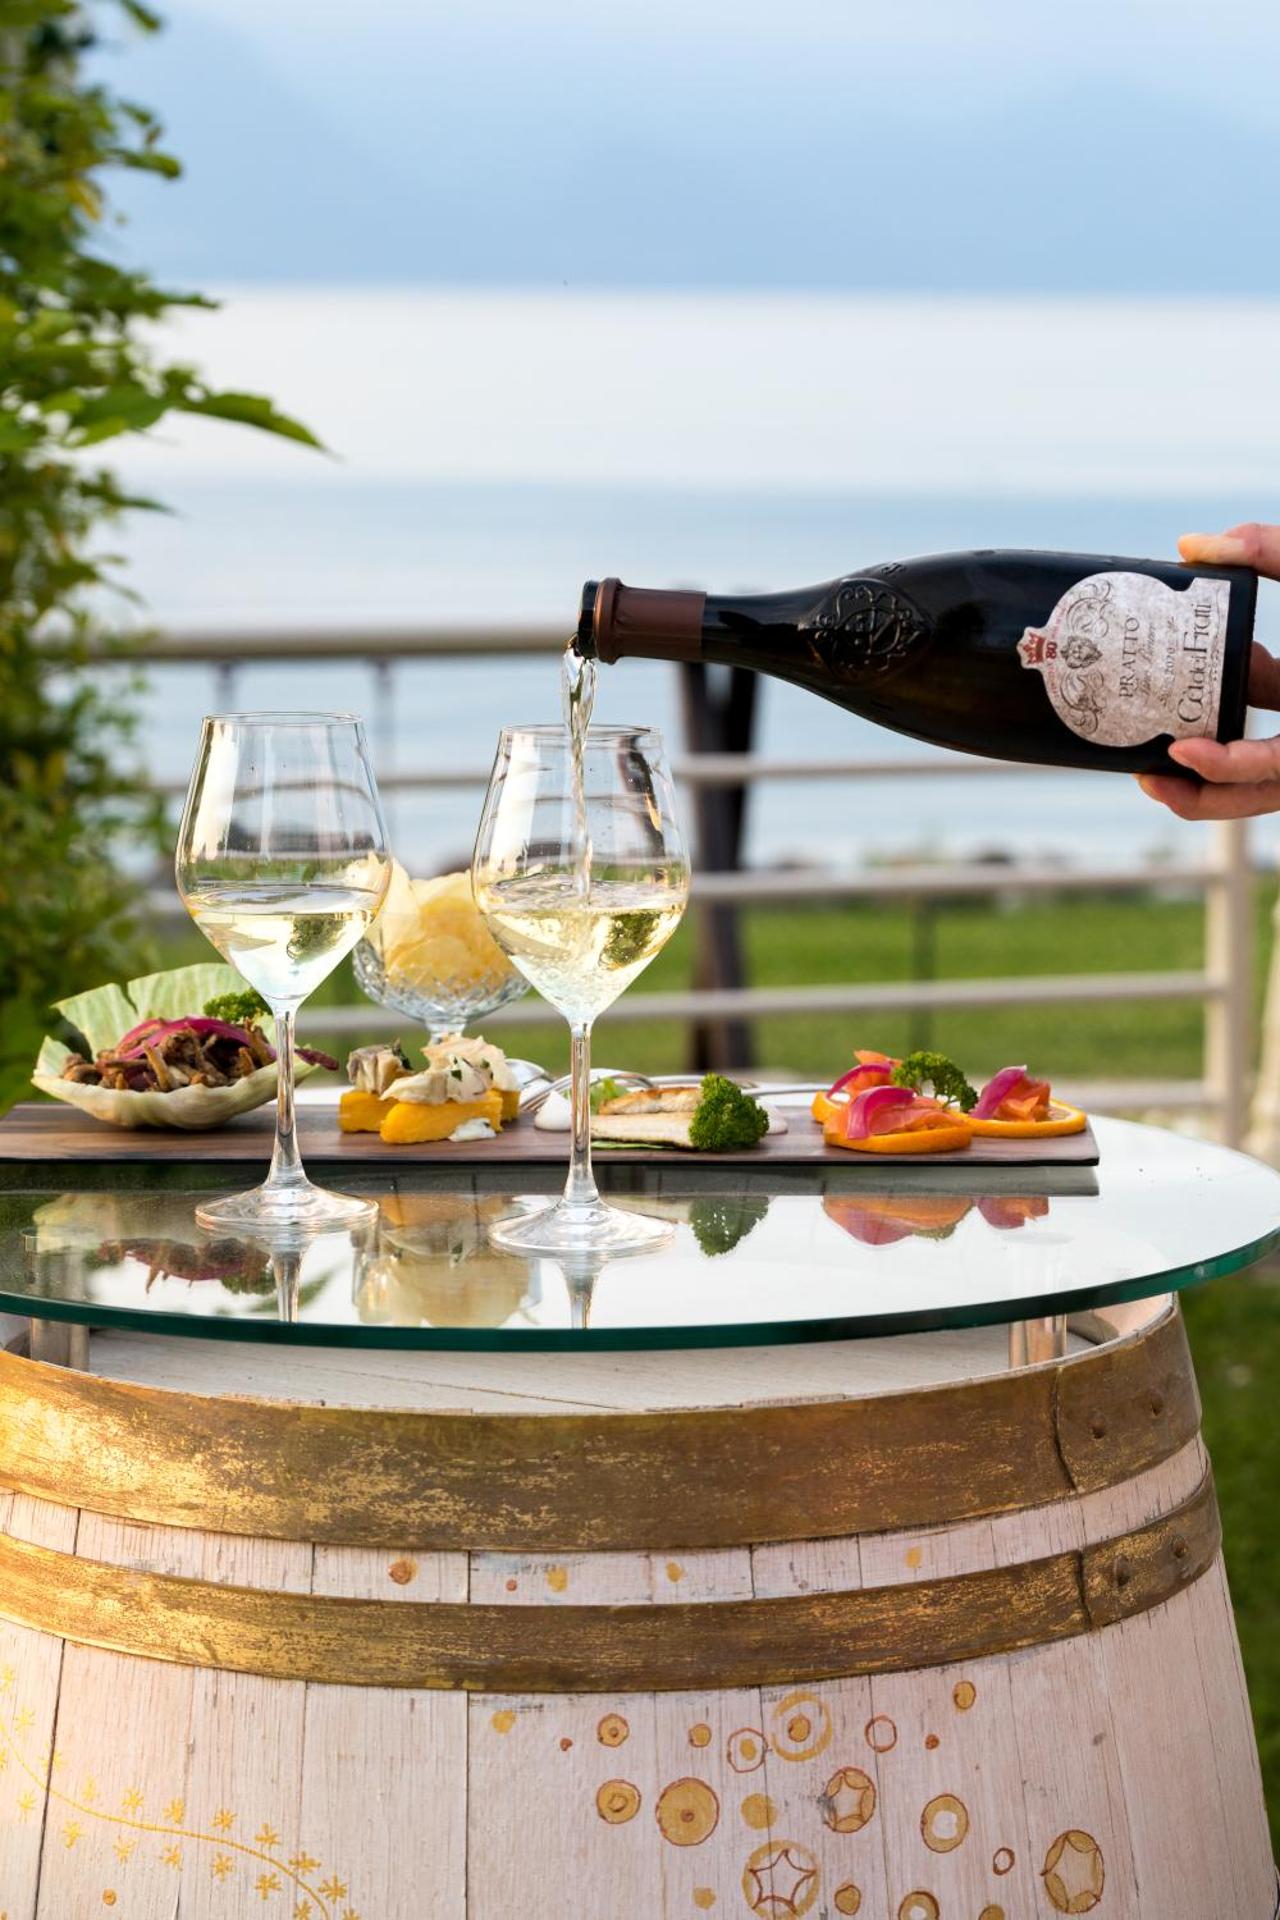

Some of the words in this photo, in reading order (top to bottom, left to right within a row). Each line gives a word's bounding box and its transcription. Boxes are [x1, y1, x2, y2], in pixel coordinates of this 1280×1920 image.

[1046, 641, 1058, 660] 80
[1183, 603, 1212, 653] Frati
[1119, 616, 1140, 698] PRATTO
